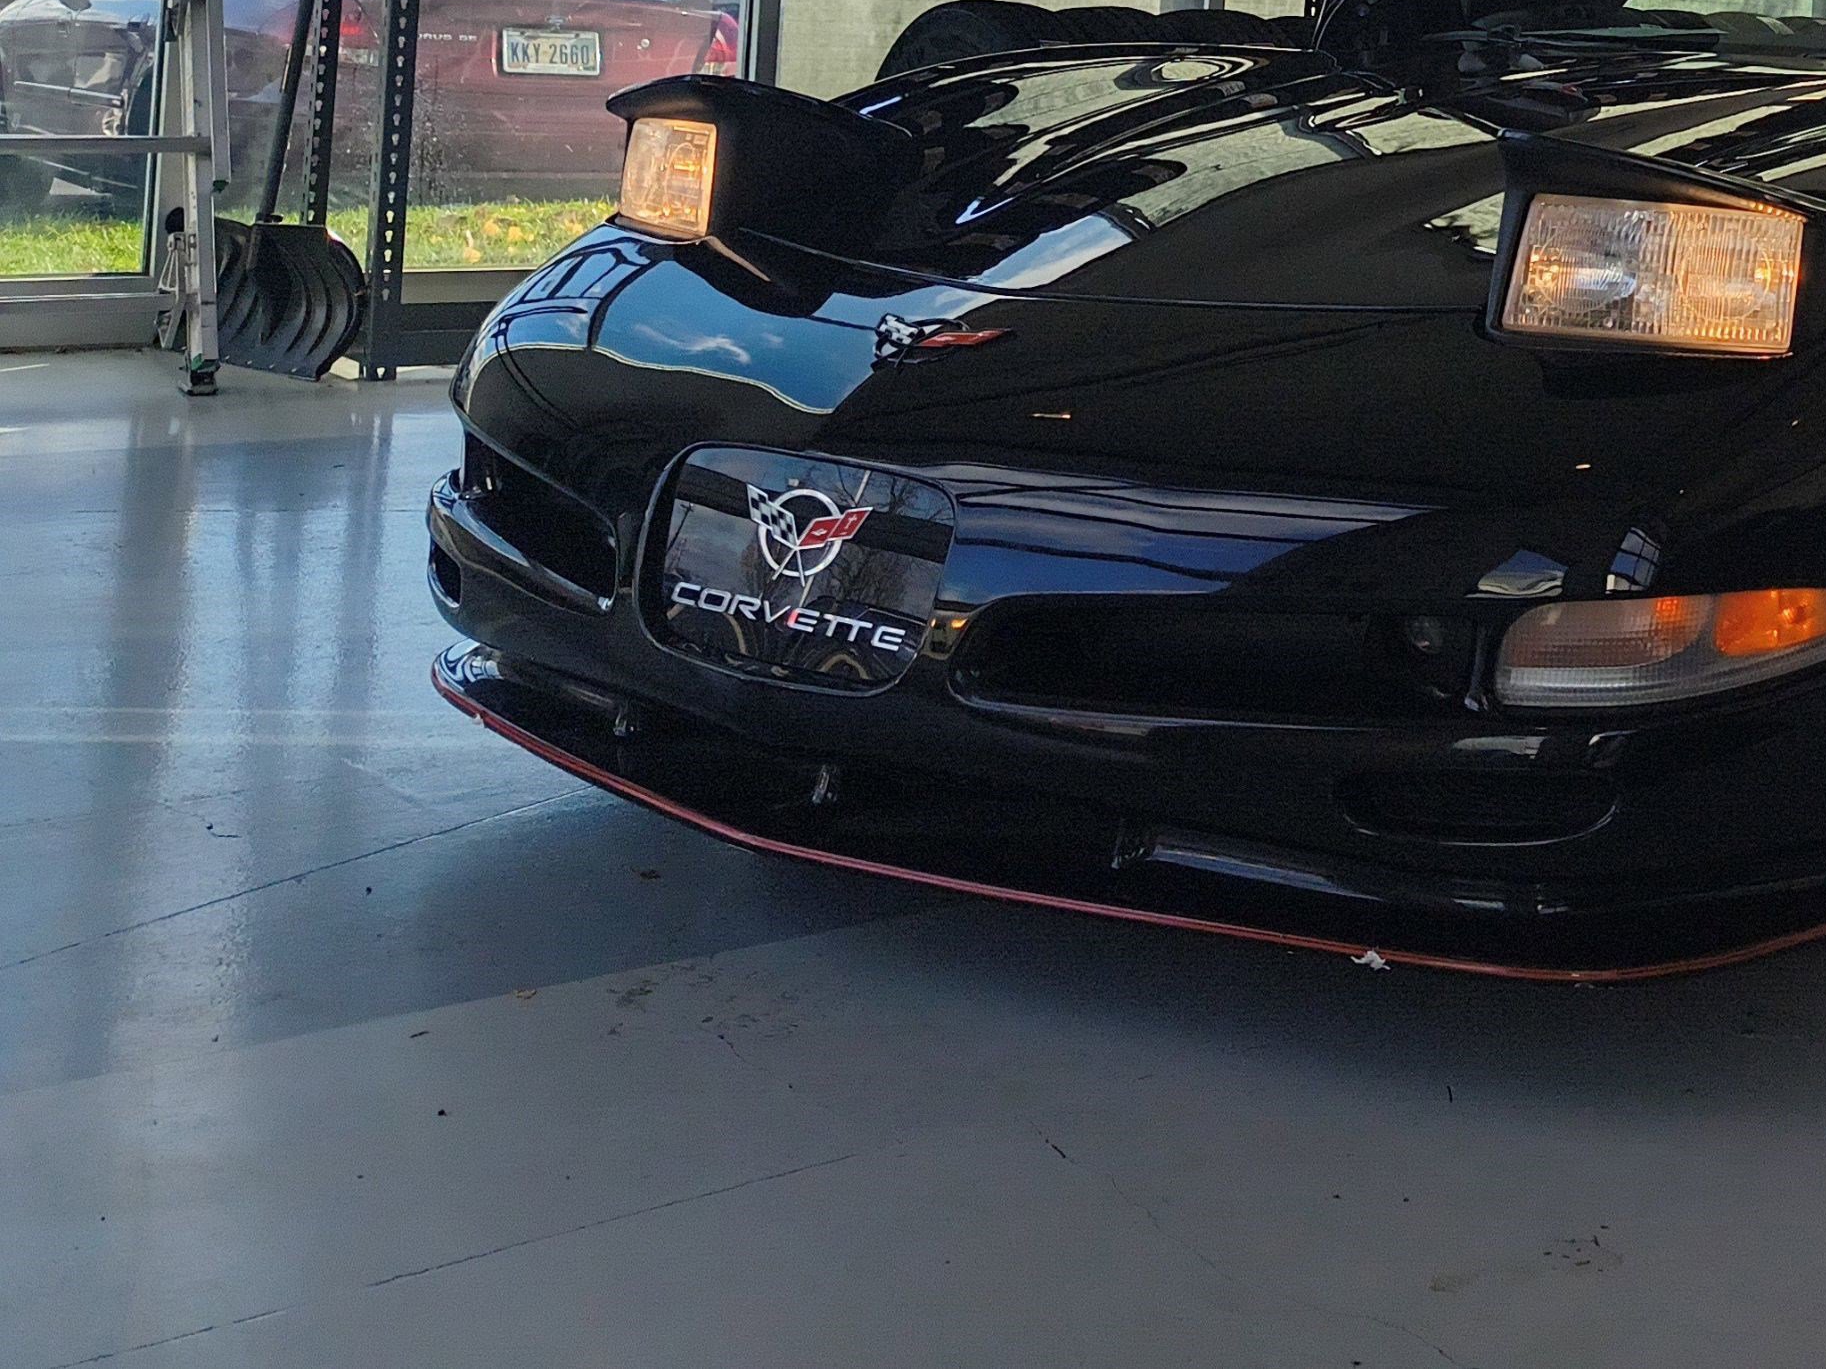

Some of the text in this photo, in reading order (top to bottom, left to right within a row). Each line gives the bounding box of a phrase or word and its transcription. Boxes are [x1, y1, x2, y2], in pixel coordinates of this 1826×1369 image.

[510, 41, 590, 65] KKY 2660
[670, 580, 907, 652] CORVETTE
